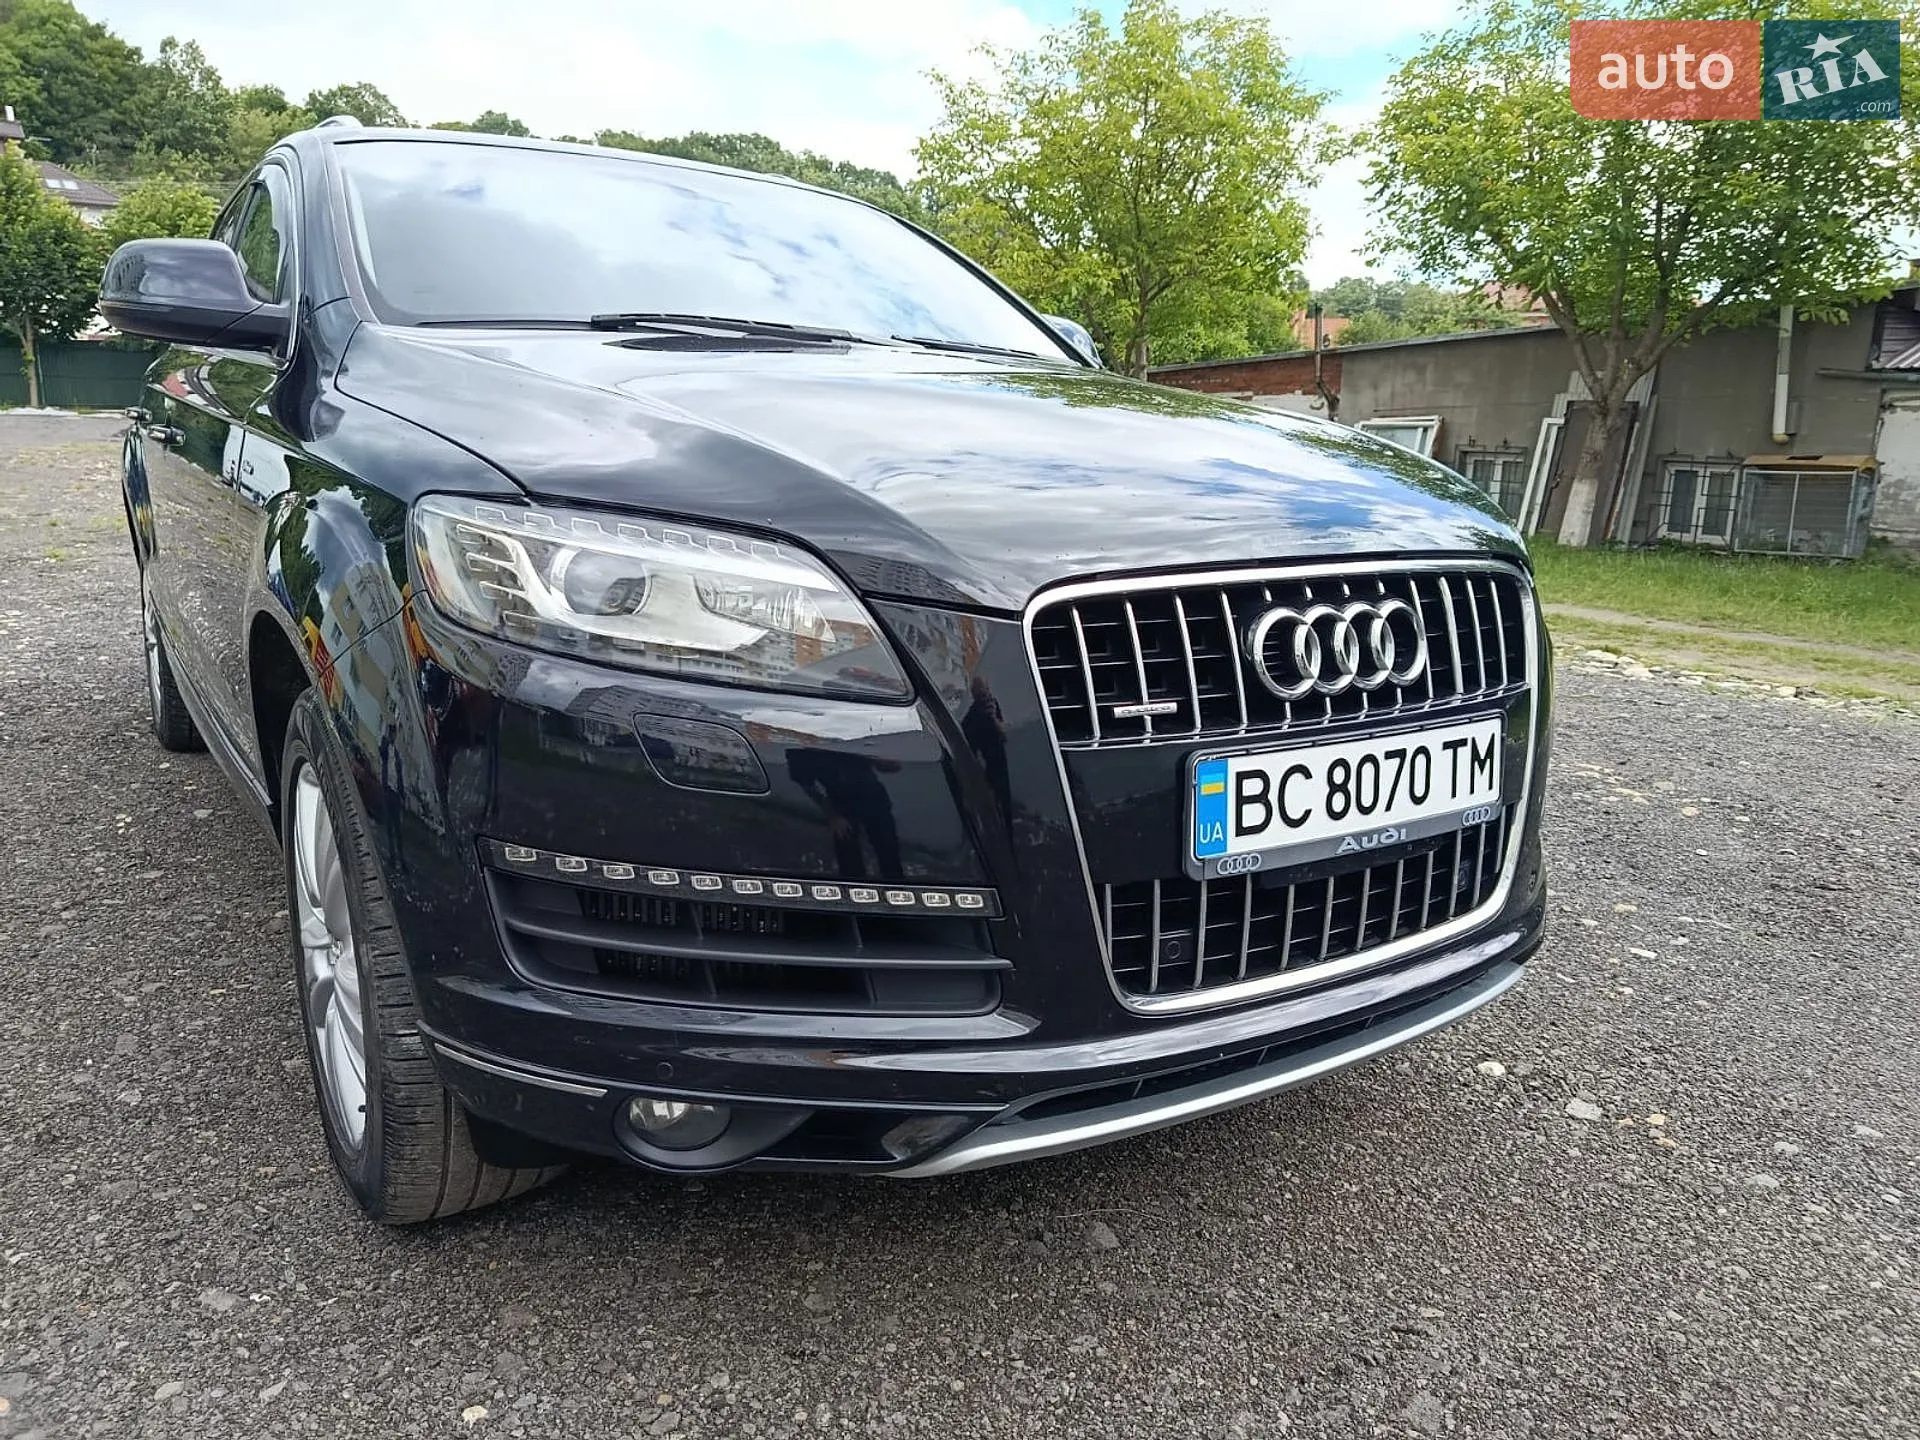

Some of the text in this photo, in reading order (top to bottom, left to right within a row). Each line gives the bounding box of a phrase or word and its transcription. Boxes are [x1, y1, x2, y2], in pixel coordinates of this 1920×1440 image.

[1235, 732, 1496, 838] BC 8070 TM
[1199, 822, 1225, 844] UA
